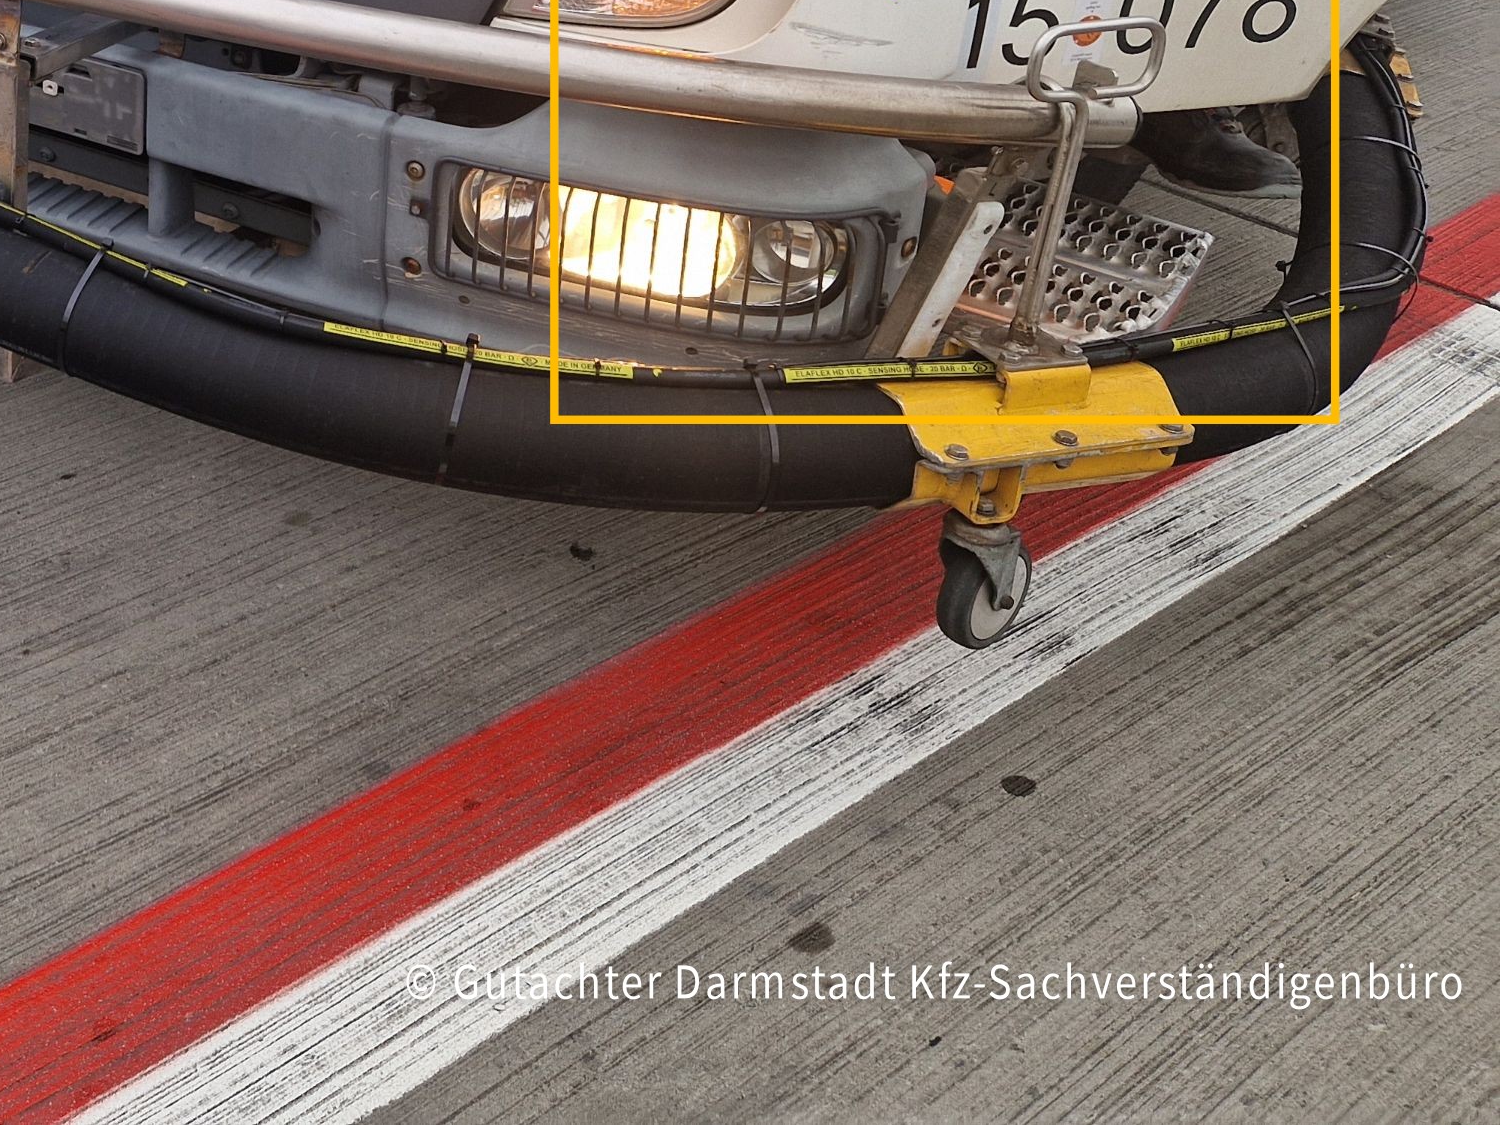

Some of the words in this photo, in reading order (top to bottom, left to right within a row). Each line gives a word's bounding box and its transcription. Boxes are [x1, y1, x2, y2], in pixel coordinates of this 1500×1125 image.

[545, 358, 570, 368] MDE
[795, 369, 831, 378] ELAFLEX
[832, 368, 845, 376] HD
[868, 365, 902, 374] SENSING
